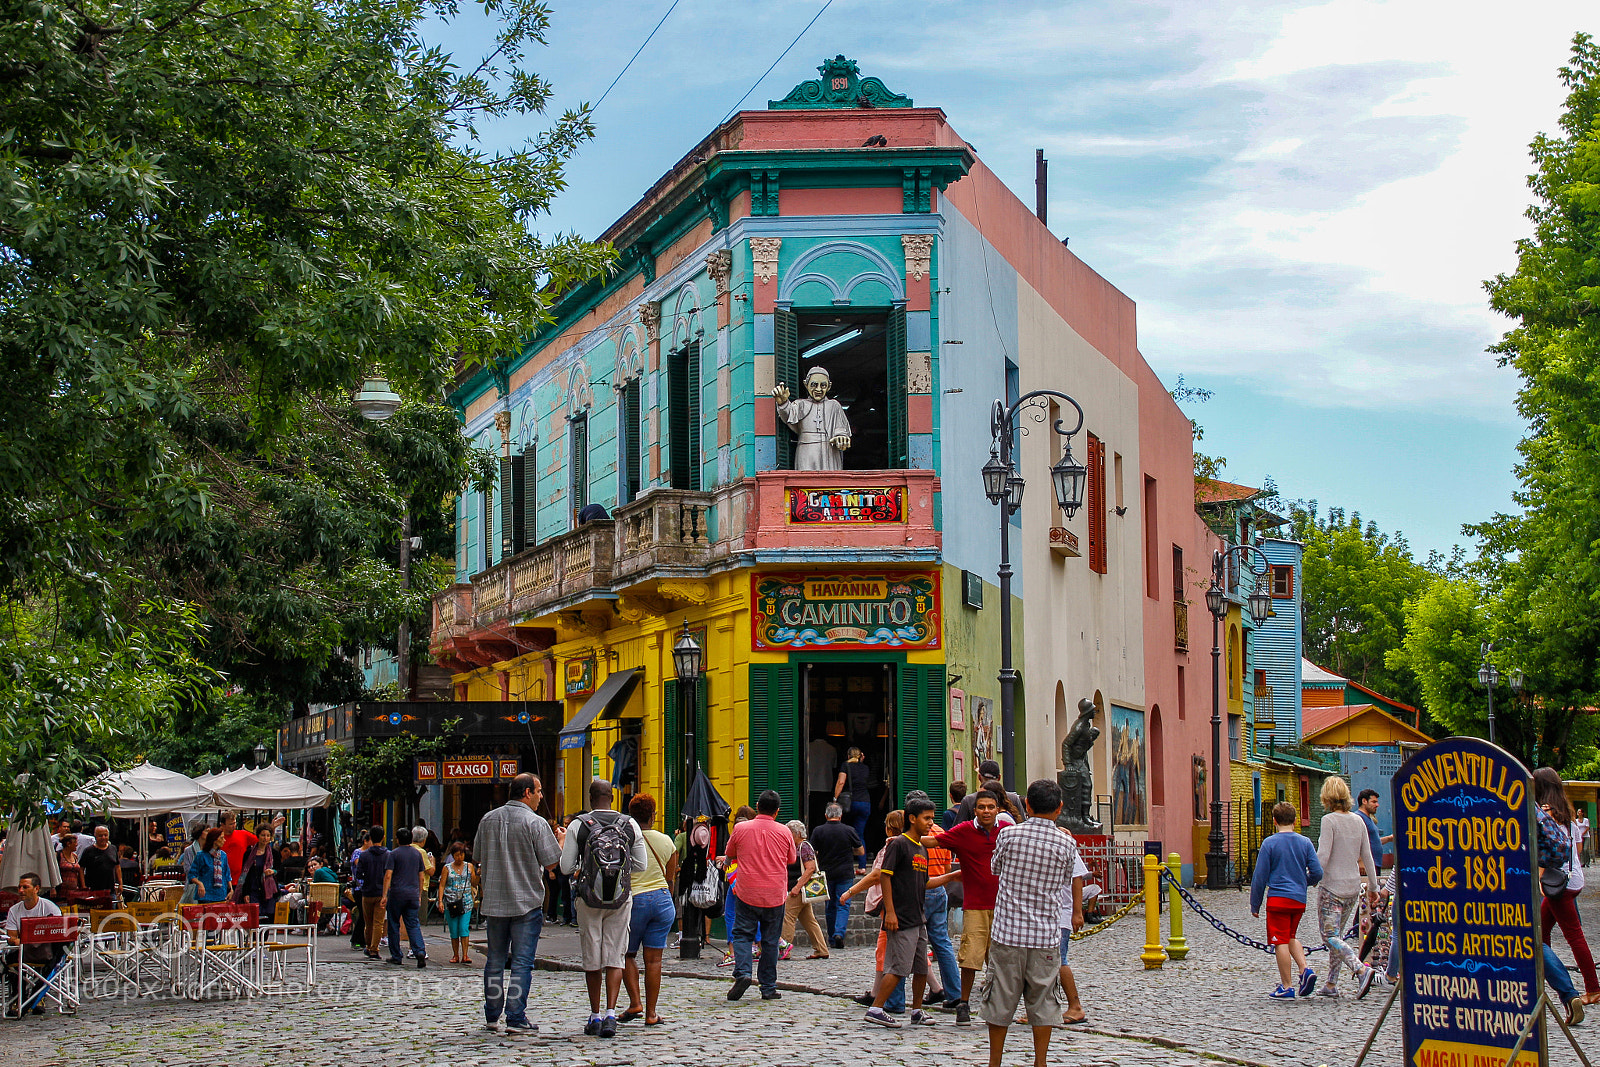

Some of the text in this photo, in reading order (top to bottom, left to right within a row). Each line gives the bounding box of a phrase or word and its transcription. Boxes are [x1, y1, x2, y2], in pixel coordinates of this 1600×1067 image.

[831, 77, 848, 90] 1891
[823, 507, 872, 516] AMIGO
[811, 583, 881, 597] HAVANNA
[767, 605, 775, 614] H
[781, 598, 912, 626] CAMINITO
[917, 603, 925, 612] H
[420, 765, 435, 776] VINO
[447, 763, 489, 776] TANGO
[501, 763, 516, 775] ARTE
[1401, 751, 1525, 812] CONVENTILLO
[1405, 816, 1521, 854] HISTORICO
[1427, 855, 1506, 892] de 1881
[1405, 900, 1532, 927] CENTRO CULTURAL
[1405, 930, 1534, 959] DE LOS ARTISTAS
[1414, 973, 1529, 1008] ENTRADA LIBRE
[1413, 1003, 1449, 1030] FREE
